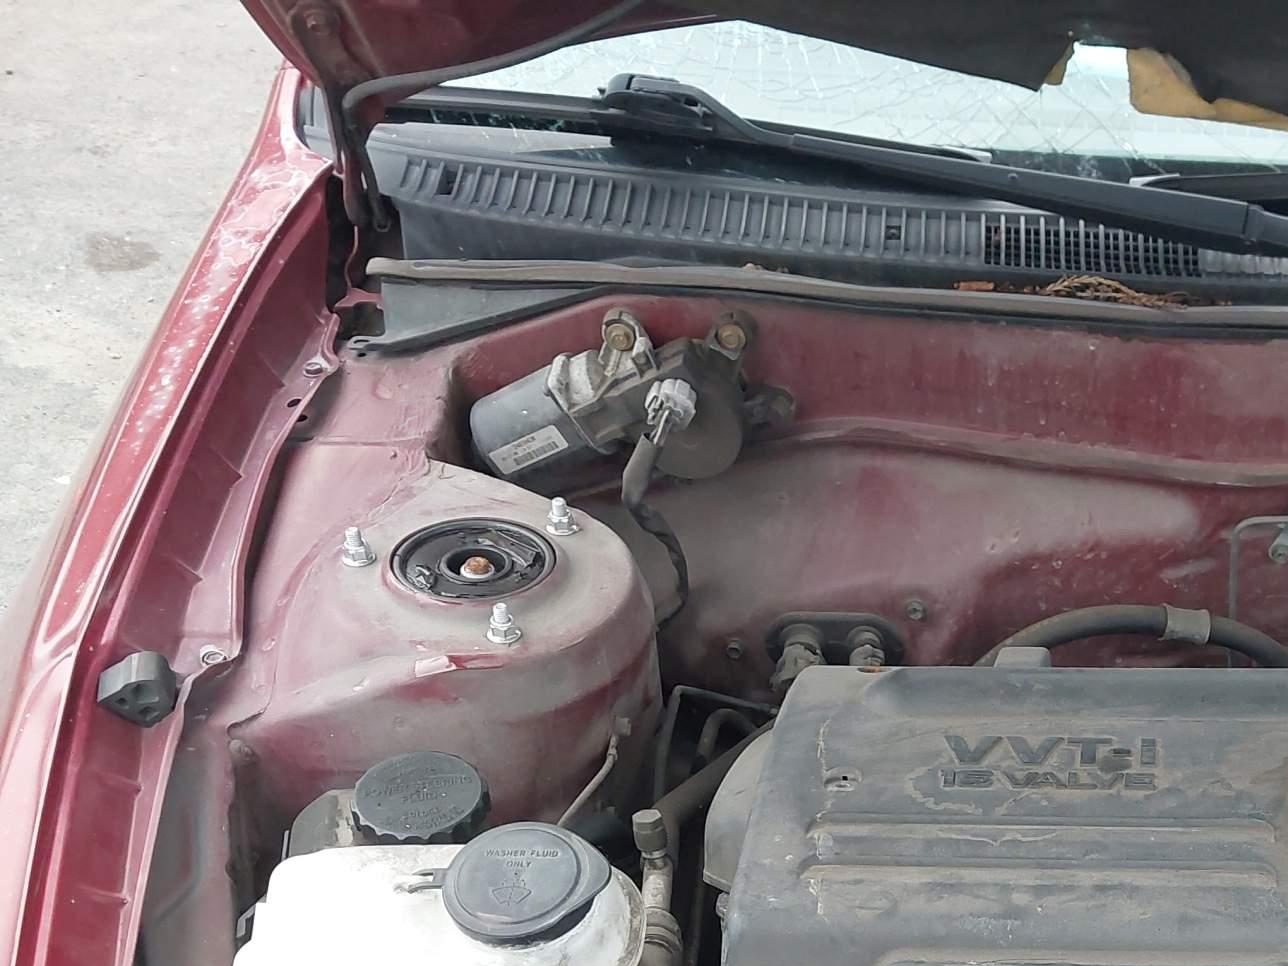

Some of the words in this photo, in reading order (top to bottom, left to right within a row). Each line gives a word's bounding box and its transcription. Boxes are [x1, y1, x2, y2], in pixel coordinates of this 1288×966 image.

[1003, 771, 1157, 789] VALVE
[485, 850, 527, 858] WASHER
[530, 849, 559, 858] FLUID
[506, 860, 533, 868] ONLY
